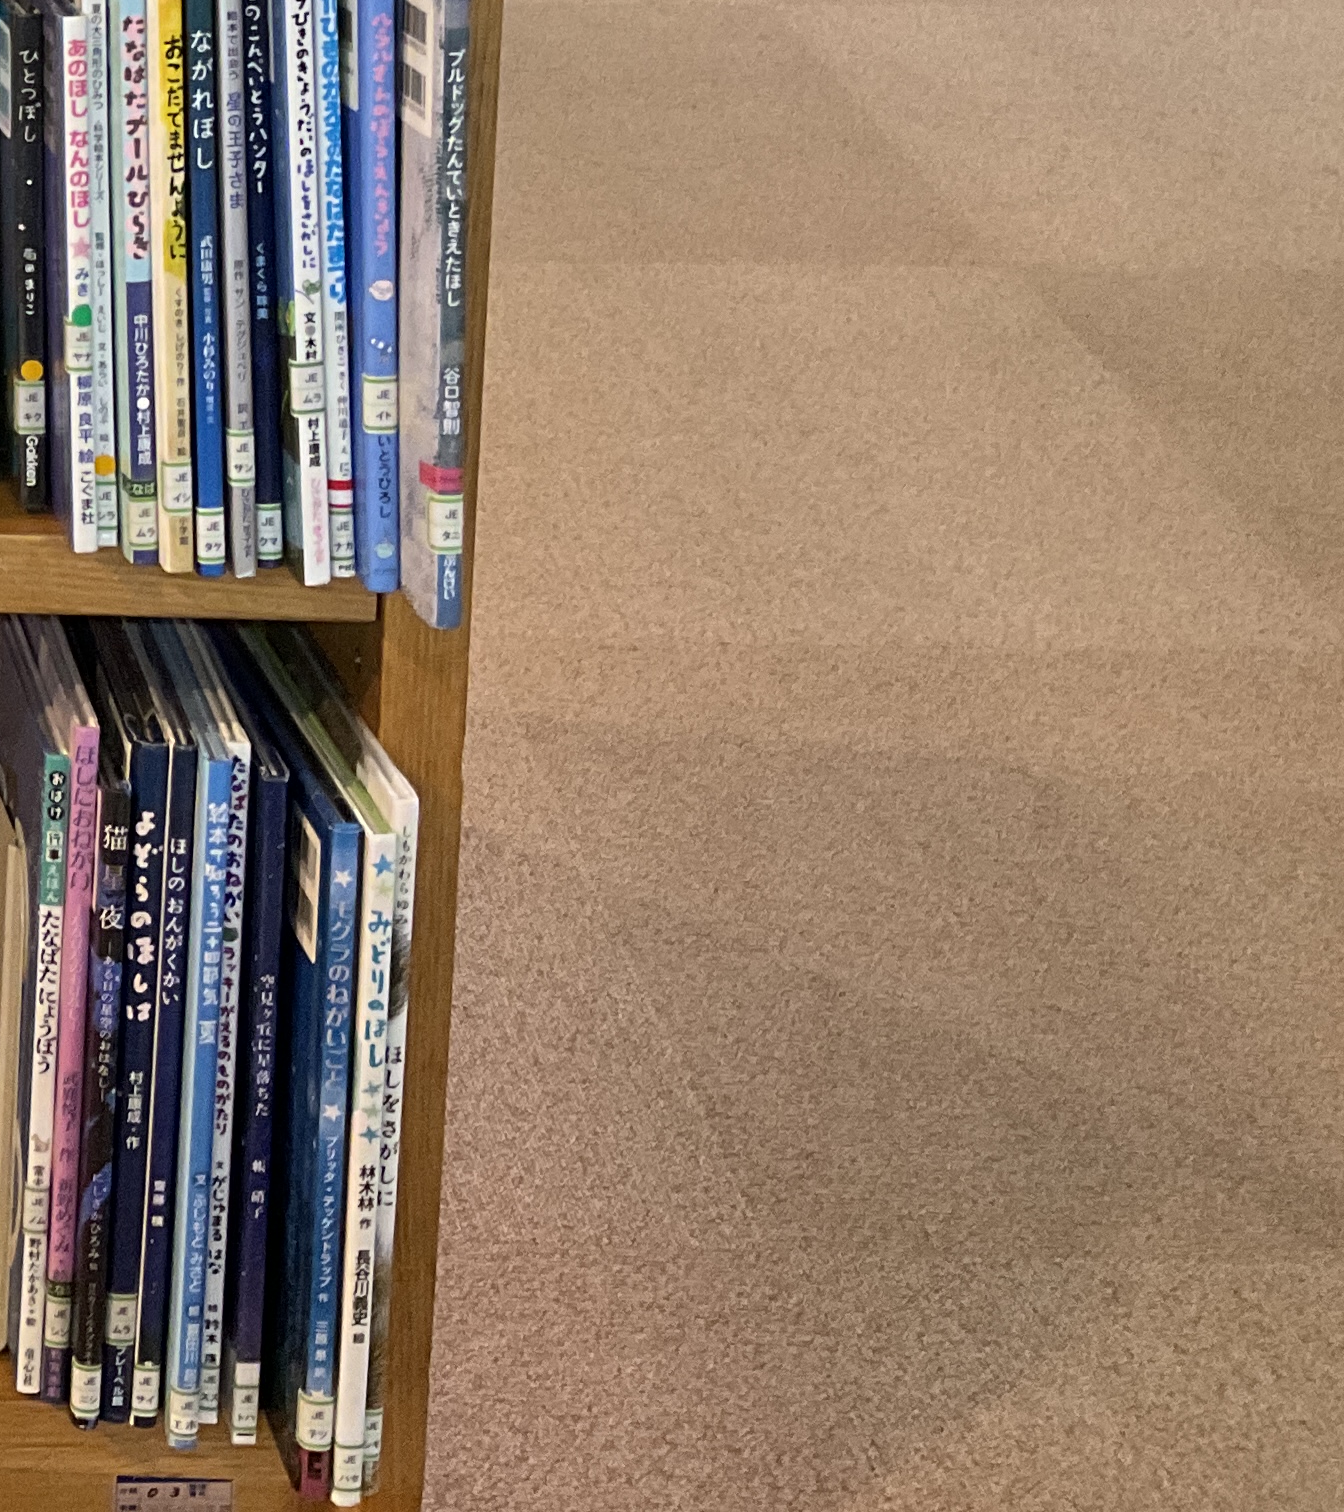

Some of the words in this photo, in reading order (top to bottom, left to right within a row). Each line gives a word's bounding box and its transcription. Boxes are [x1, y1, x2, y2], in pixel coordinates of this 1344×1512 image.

[18, 50, 41, 143] ひとつぼし
[67, 39, 89, 119] あのほし
[190, 29, 214, 170] ながれぼし
[69, 130, 91, 229] なんのほし
[122, 14, 149, 260] たなばたプールびらき
[164, 34, 186, 261] おこだでませんように
[376, 390, 391, 400] JE
[175, 473, 188, 482] JE
[236, 443, 250, 453] JE
[79, 471, 95, 525] こぐま社
[126, 810, 163, 1022] よぞらのほしは
[161, 898, 185, 1006] おんがくかい
[363, 909, 392, 1069] みどりのほし
[376, 1044, 405, 1208] ほしをさがしに
[356, 1163, 377, 1212] 林木林
